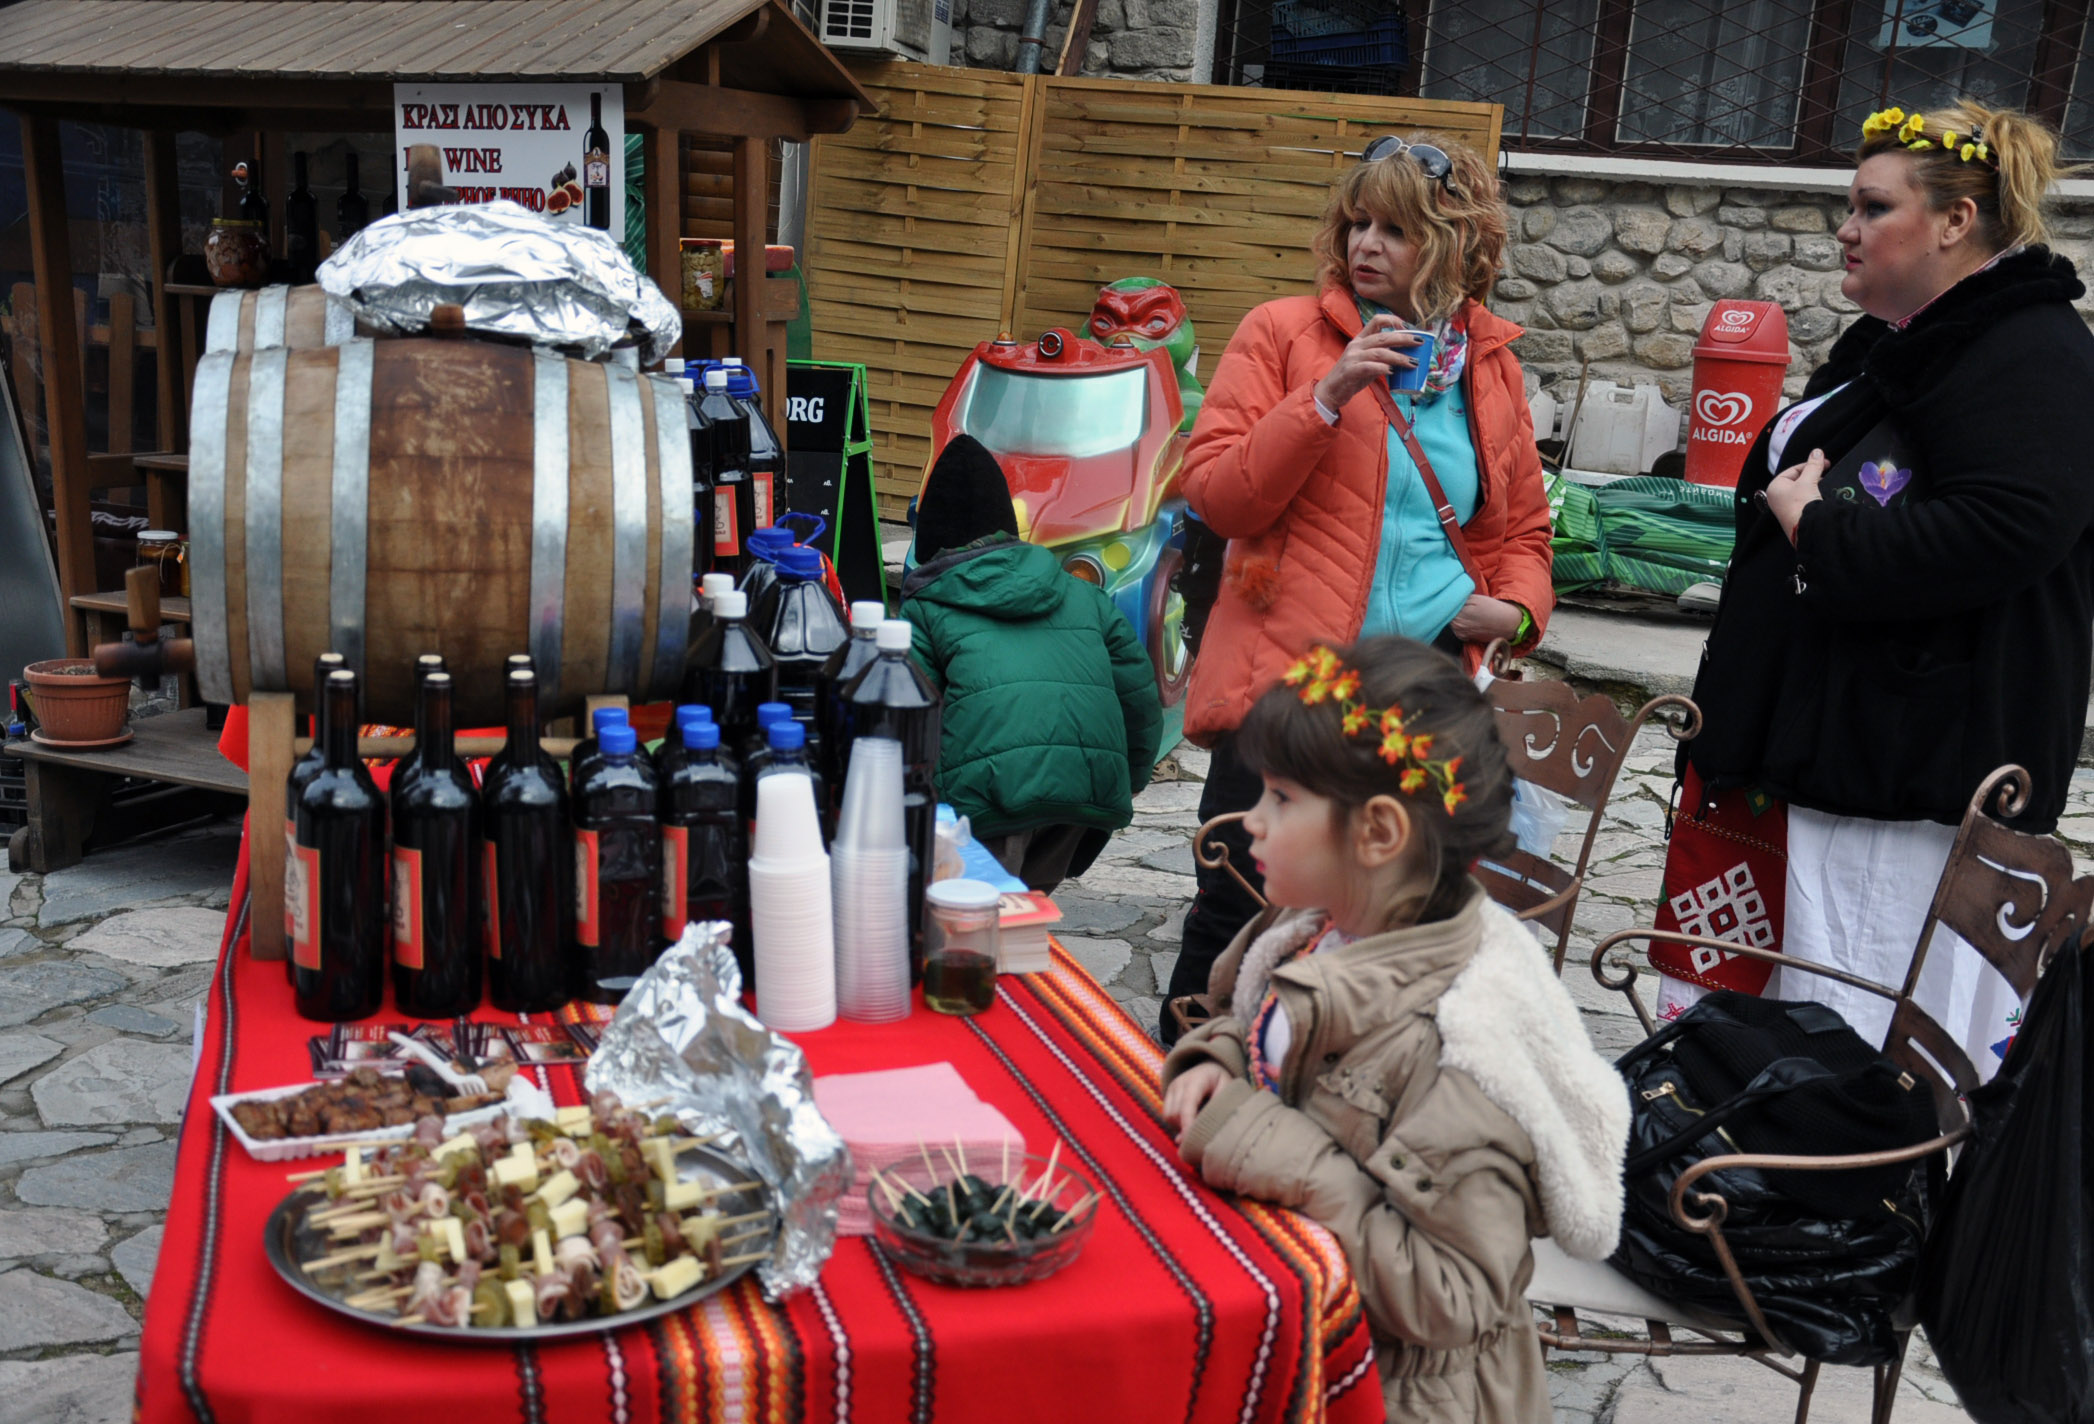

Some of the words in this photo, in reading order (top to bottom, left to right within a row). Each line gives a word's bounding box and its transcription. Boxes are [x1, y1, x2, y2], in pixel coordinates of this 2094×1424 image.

[401, 103, 460, 130] ΚΡΑΣΙ
[462, 104, 509, 130] ΑΠΟ
[510, 104, 571, 130] ΣΥΚΑ
[443, 147, 503, 173] WINE
